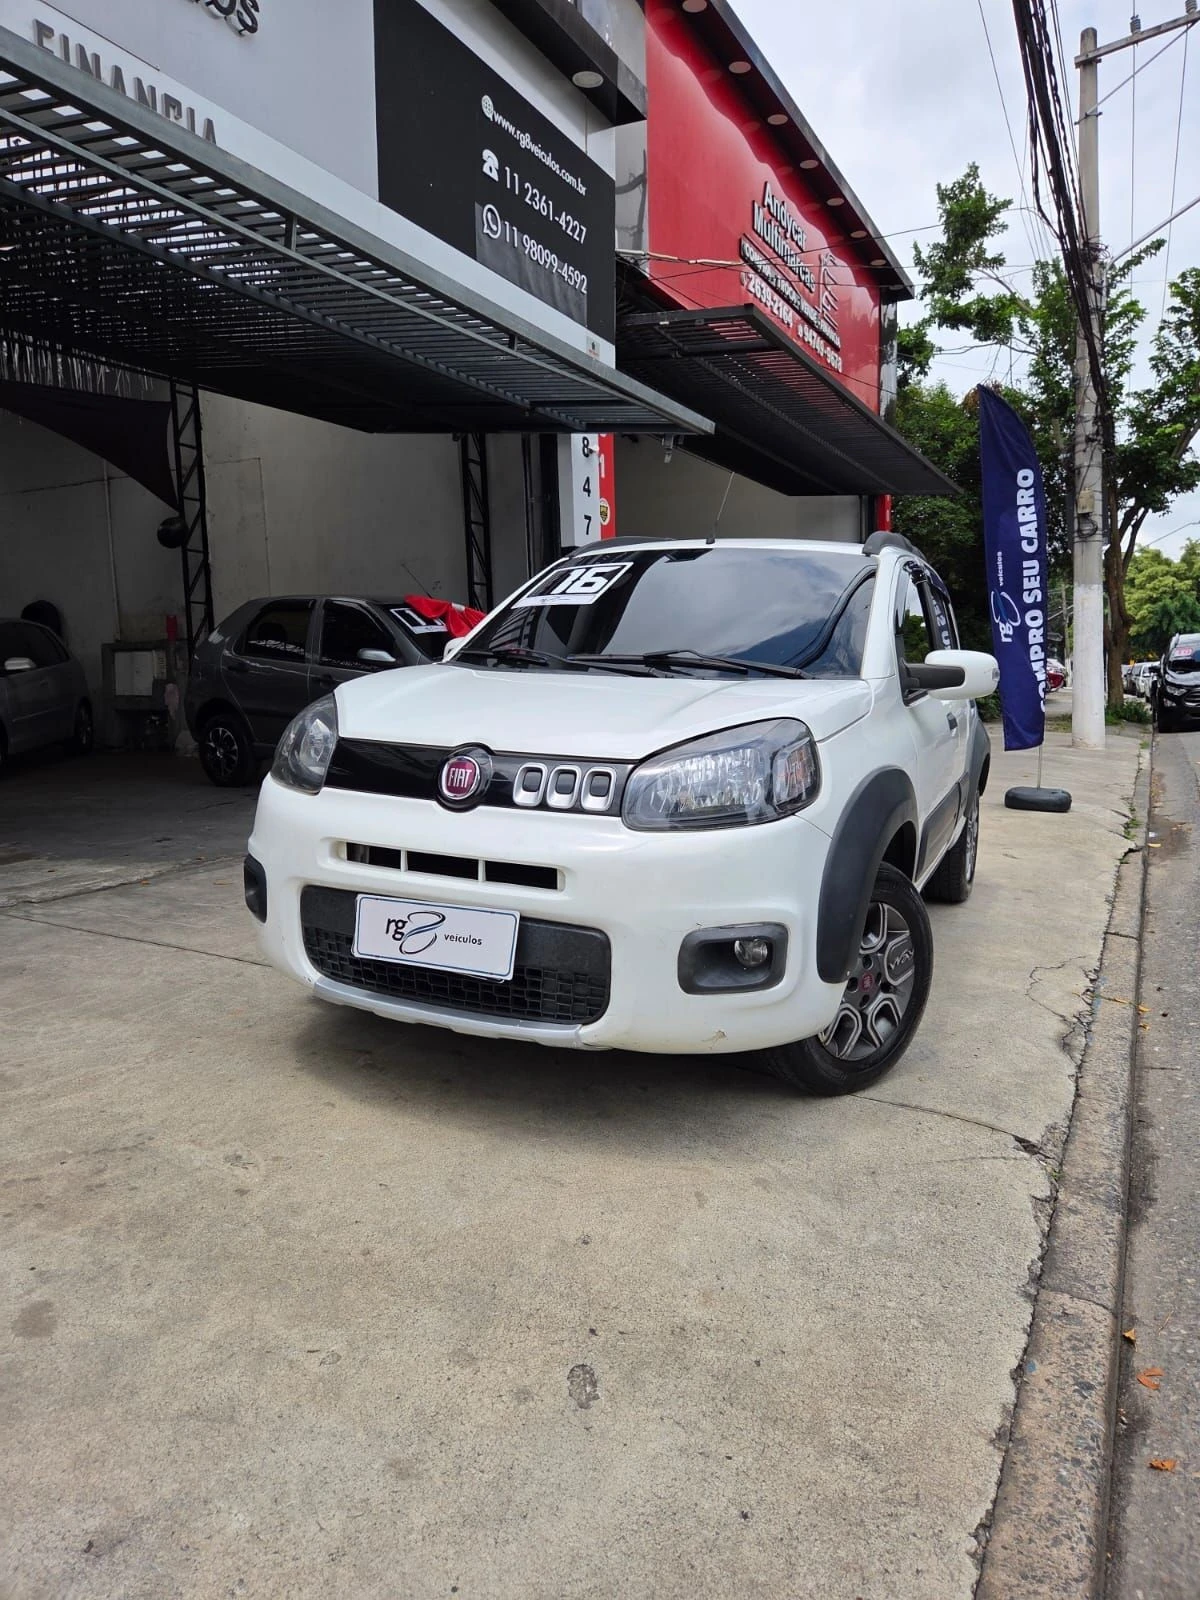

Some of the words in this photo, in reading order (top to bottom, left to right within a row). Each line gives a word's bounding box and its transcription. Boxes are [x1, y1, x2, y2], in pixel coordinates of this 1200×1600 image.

[492, 110, 587, 196] www.rg8veiculos.com.br
[505, 166, 519, 195] 11
[524, 182, 587, 244] 2361-4227
[763, 181, 807, 252] Andycar
[504, 221, 519, 248] 11
[522, 234, 588, 294] 98099-4592
[752, 200, 816, 293] Multimarcas
[1016, 468, 1038, 554] CARRO
[550, 566, 621, 595] 16
[1022, 559, 1042, 604] SEU
[447, 767, 473, 788] FIAT
